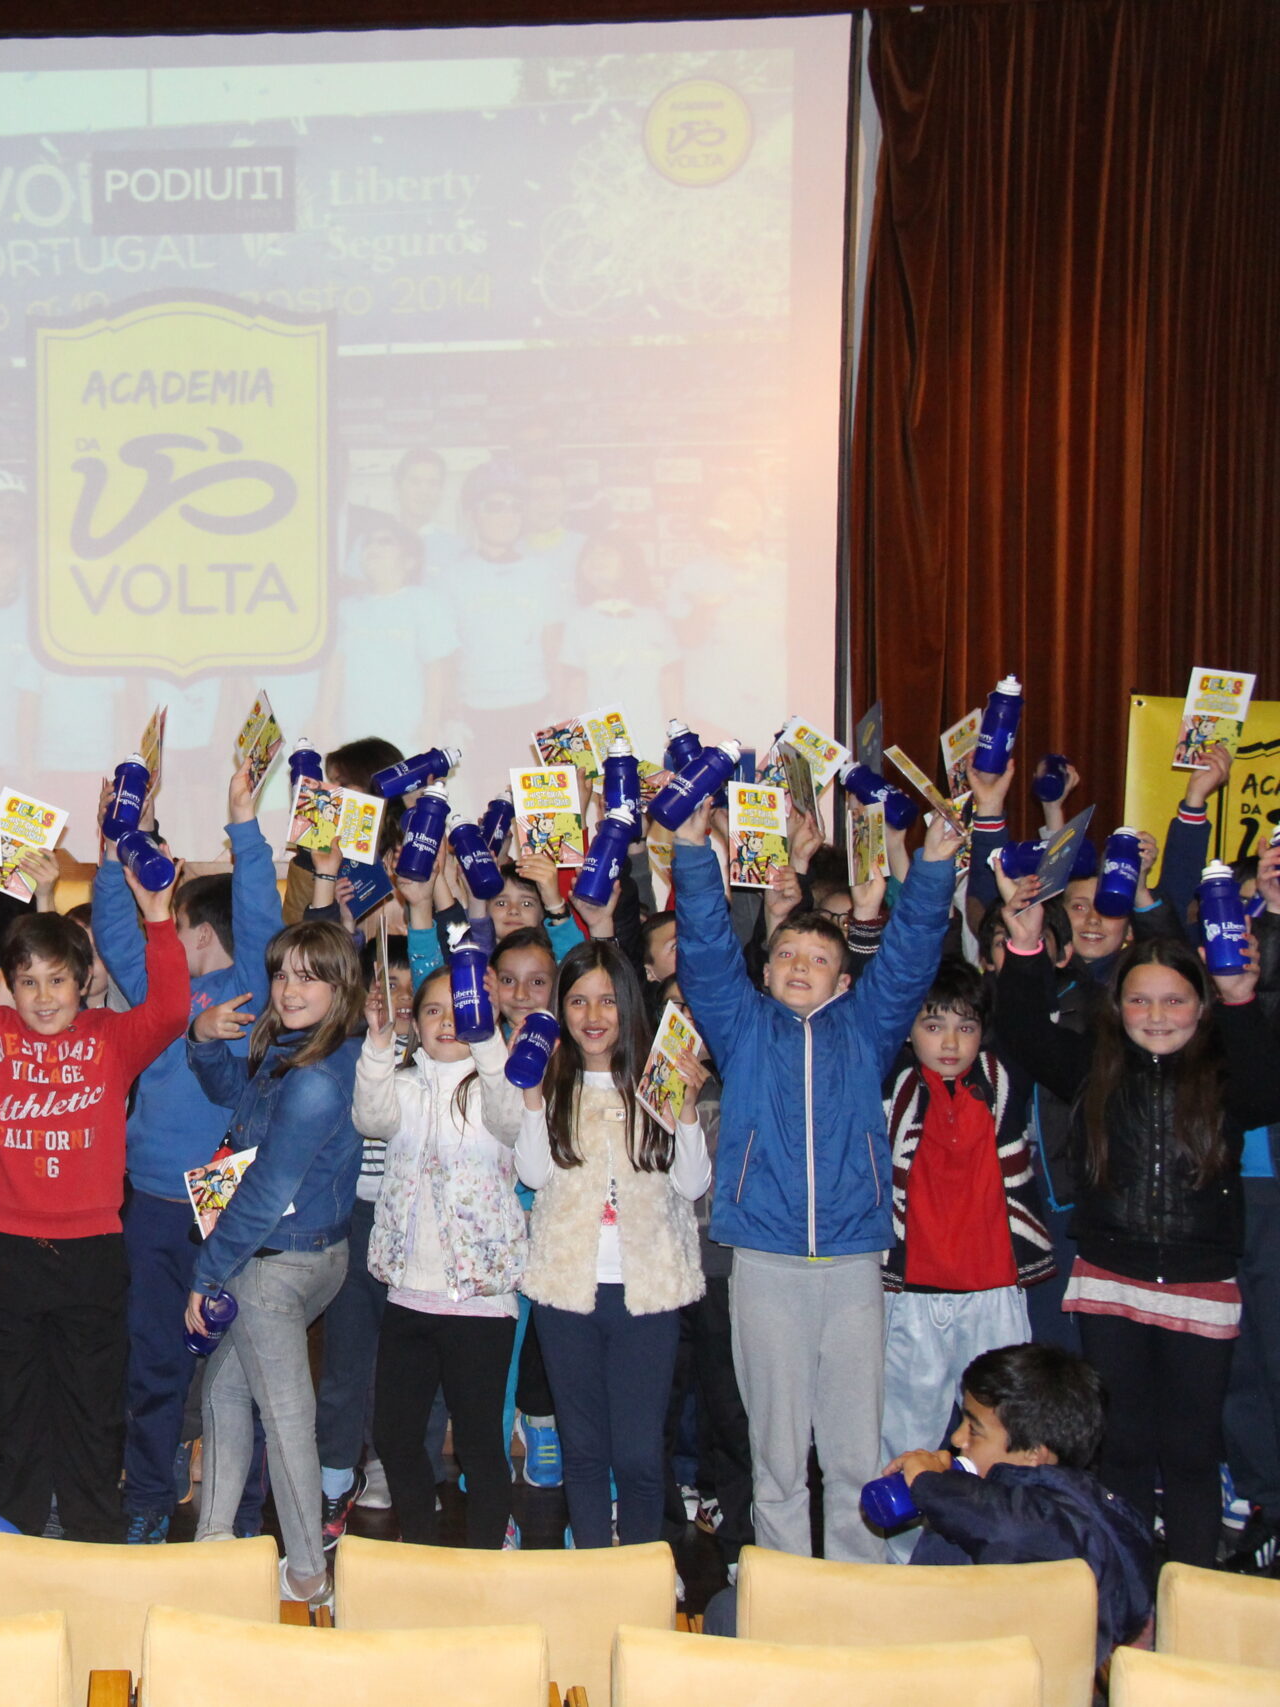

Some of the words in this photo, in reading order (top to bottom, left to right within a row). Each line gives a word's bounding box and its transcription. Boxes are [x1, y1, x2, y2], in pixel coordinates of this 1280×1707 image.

[104, 165, 283, 203] PODIUM
[328, 166, 481, 216] Liberty
[327, 224, 490, 273] Seguros
[237, 278, 374, 316] osto
[391, 272, 492, 313] 2014
[80, 367, 276, 410] ACADEMIA
[75, 437, 101, 451] DA
[69, 561, 300, 616] VOLTA
[522, 772, 568, 790] CICLAS
[1241, 773, 1280, 798] AC
[738, 790, 776, 809] CICLAS
[1240, 803, 1262, 815] DA
[8, 799, 55, 828] CICLAS
[356, 805, 376, 852] CICLAS
[1221, 922, 1246, 930] Libe
[1222, 932, 1243, 942] Segu
[12, 1059, 85, 1085] VILLAGE
[34, 1156, 60, 1178] 96
